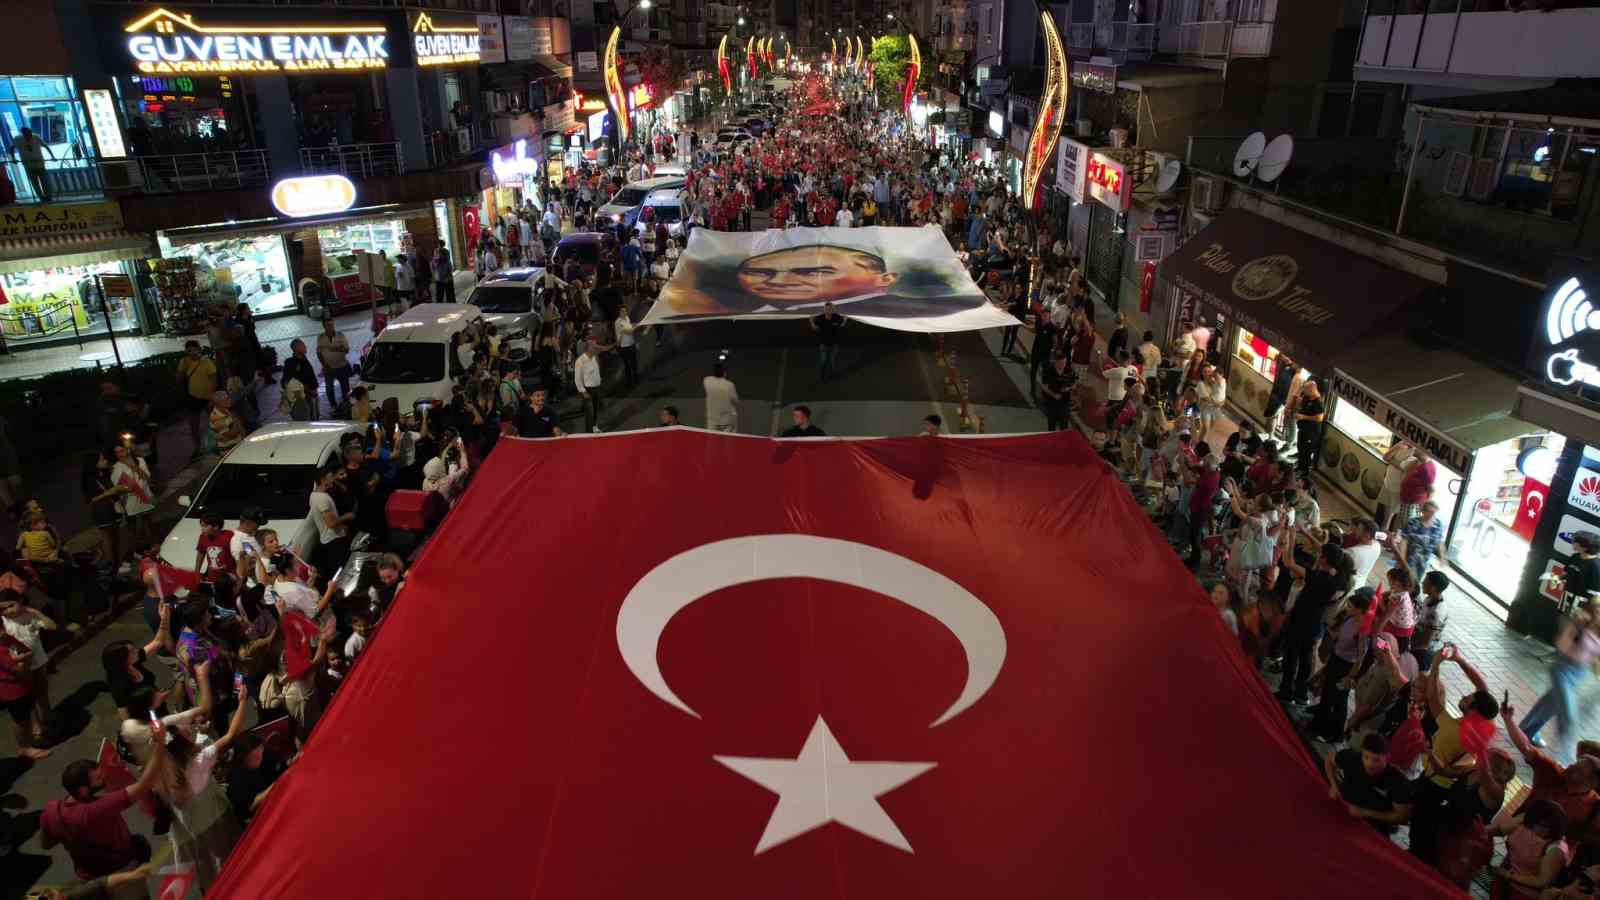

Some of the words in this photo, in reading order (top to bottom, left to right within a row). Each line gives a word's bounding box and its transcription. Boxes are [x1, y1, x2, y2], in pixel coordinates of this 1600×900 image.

[271, 35, 389, 59] EMLAK
[1333, 375, 1378, 414] KAHVE
[1386, 409, 1469, 474] KARNAVALI
